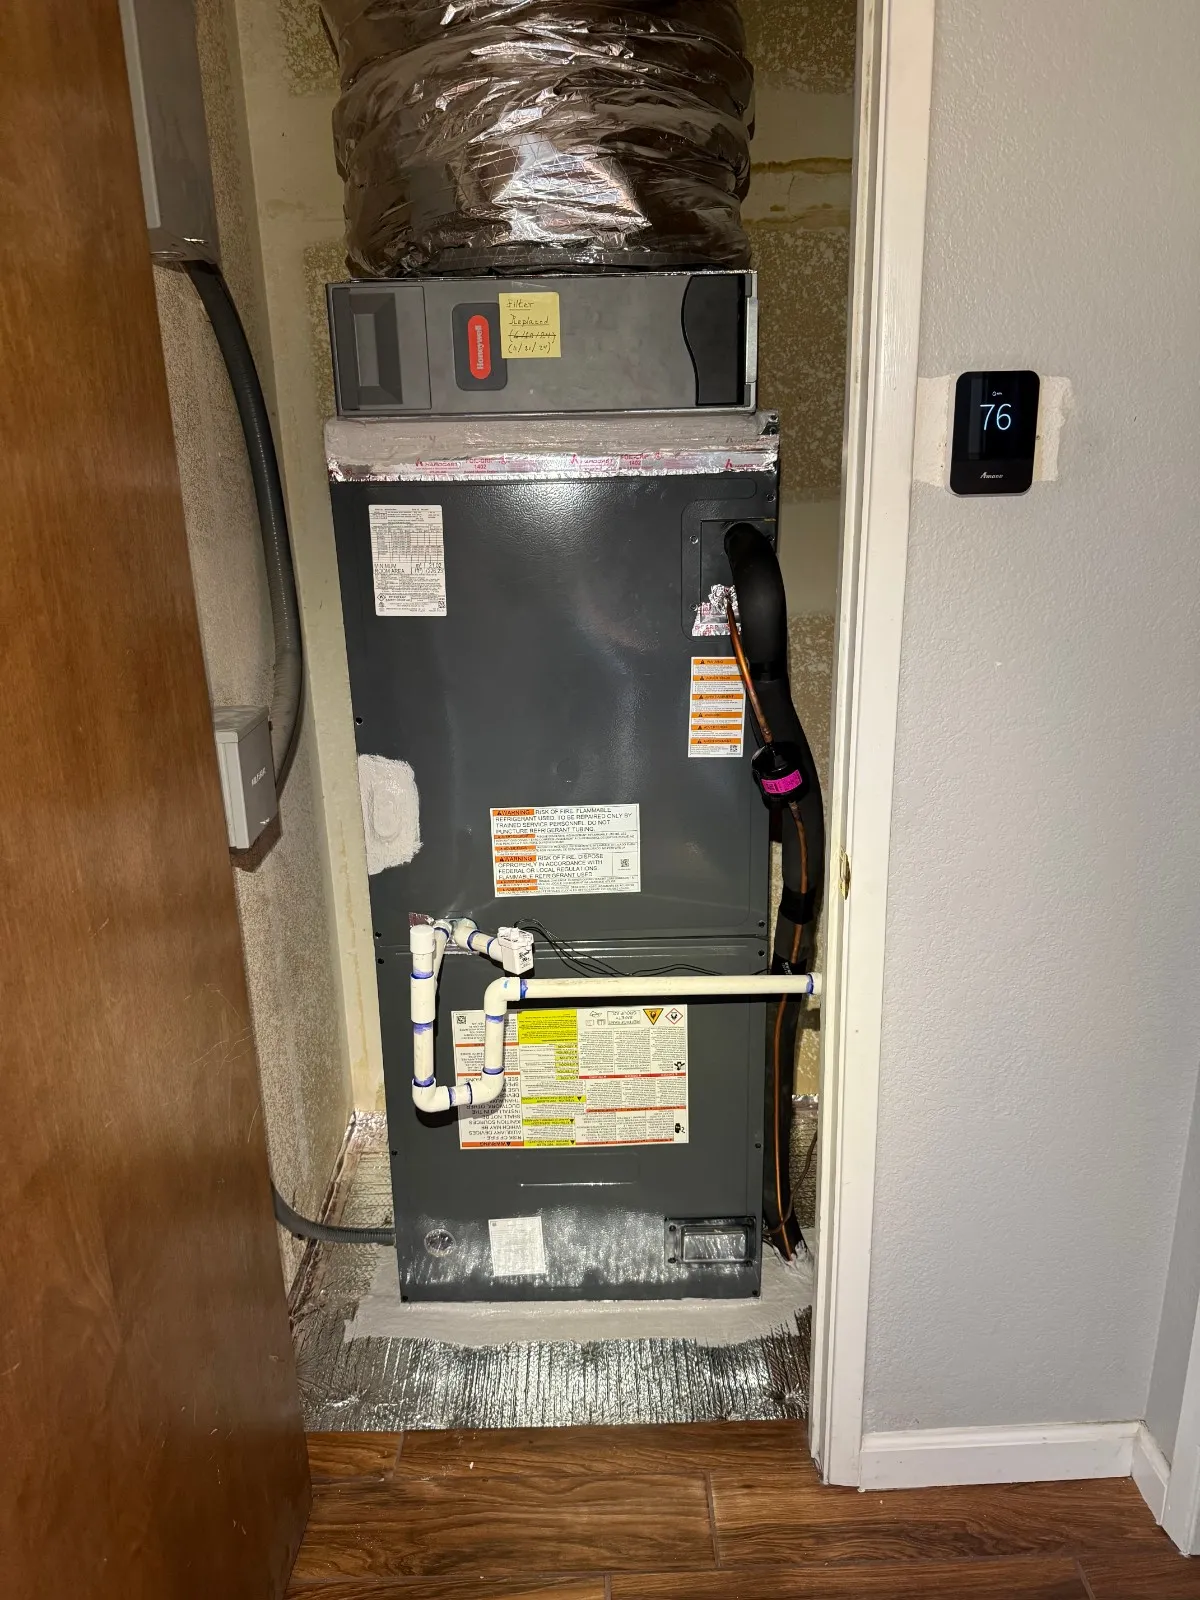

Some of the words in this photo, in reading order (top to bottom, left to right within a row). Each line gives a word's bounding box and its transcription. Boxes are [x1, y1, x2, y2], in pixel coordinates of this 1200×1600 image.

[506, 299, 535, 309] Filter
[509, 314, 550, 327] Replaced
[474, 325, 484, 370] Honeywell
[980, 403, 1012, 431] 76
[979, 471, 1004, 480] Amana
[495, 815, 537, 823] REFRIGERANT
